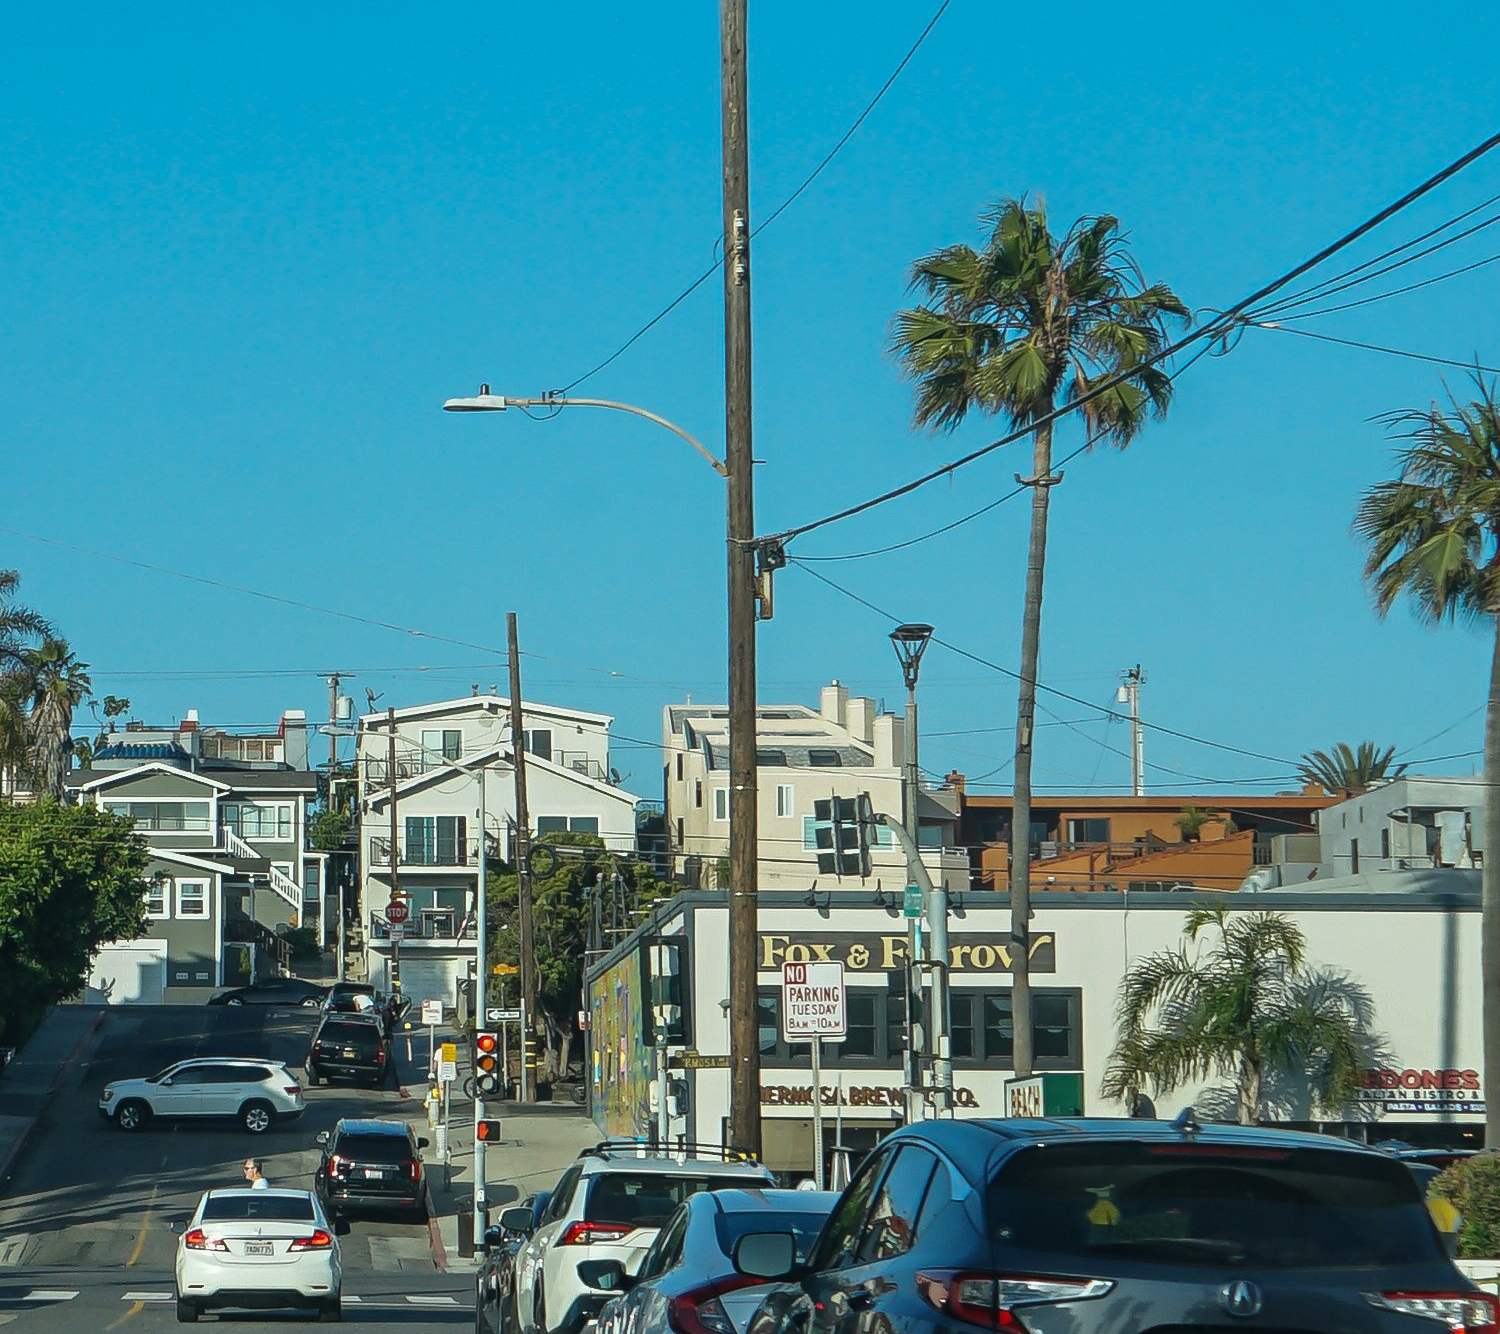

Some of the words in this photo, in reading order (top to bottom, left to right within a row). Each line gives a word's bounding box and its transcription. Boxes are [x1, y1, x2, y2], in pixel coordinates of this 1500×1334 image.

[387, 907, 408, 918] STOP
[847, 943, 869, 969] &
[786, 965, 805, 983] NO
[789, 986, 840, 1003] PARKING
[791, 1004, 838, 1016] TUESDAY
[1413, 1090, 1466, 1100] BISTRO
